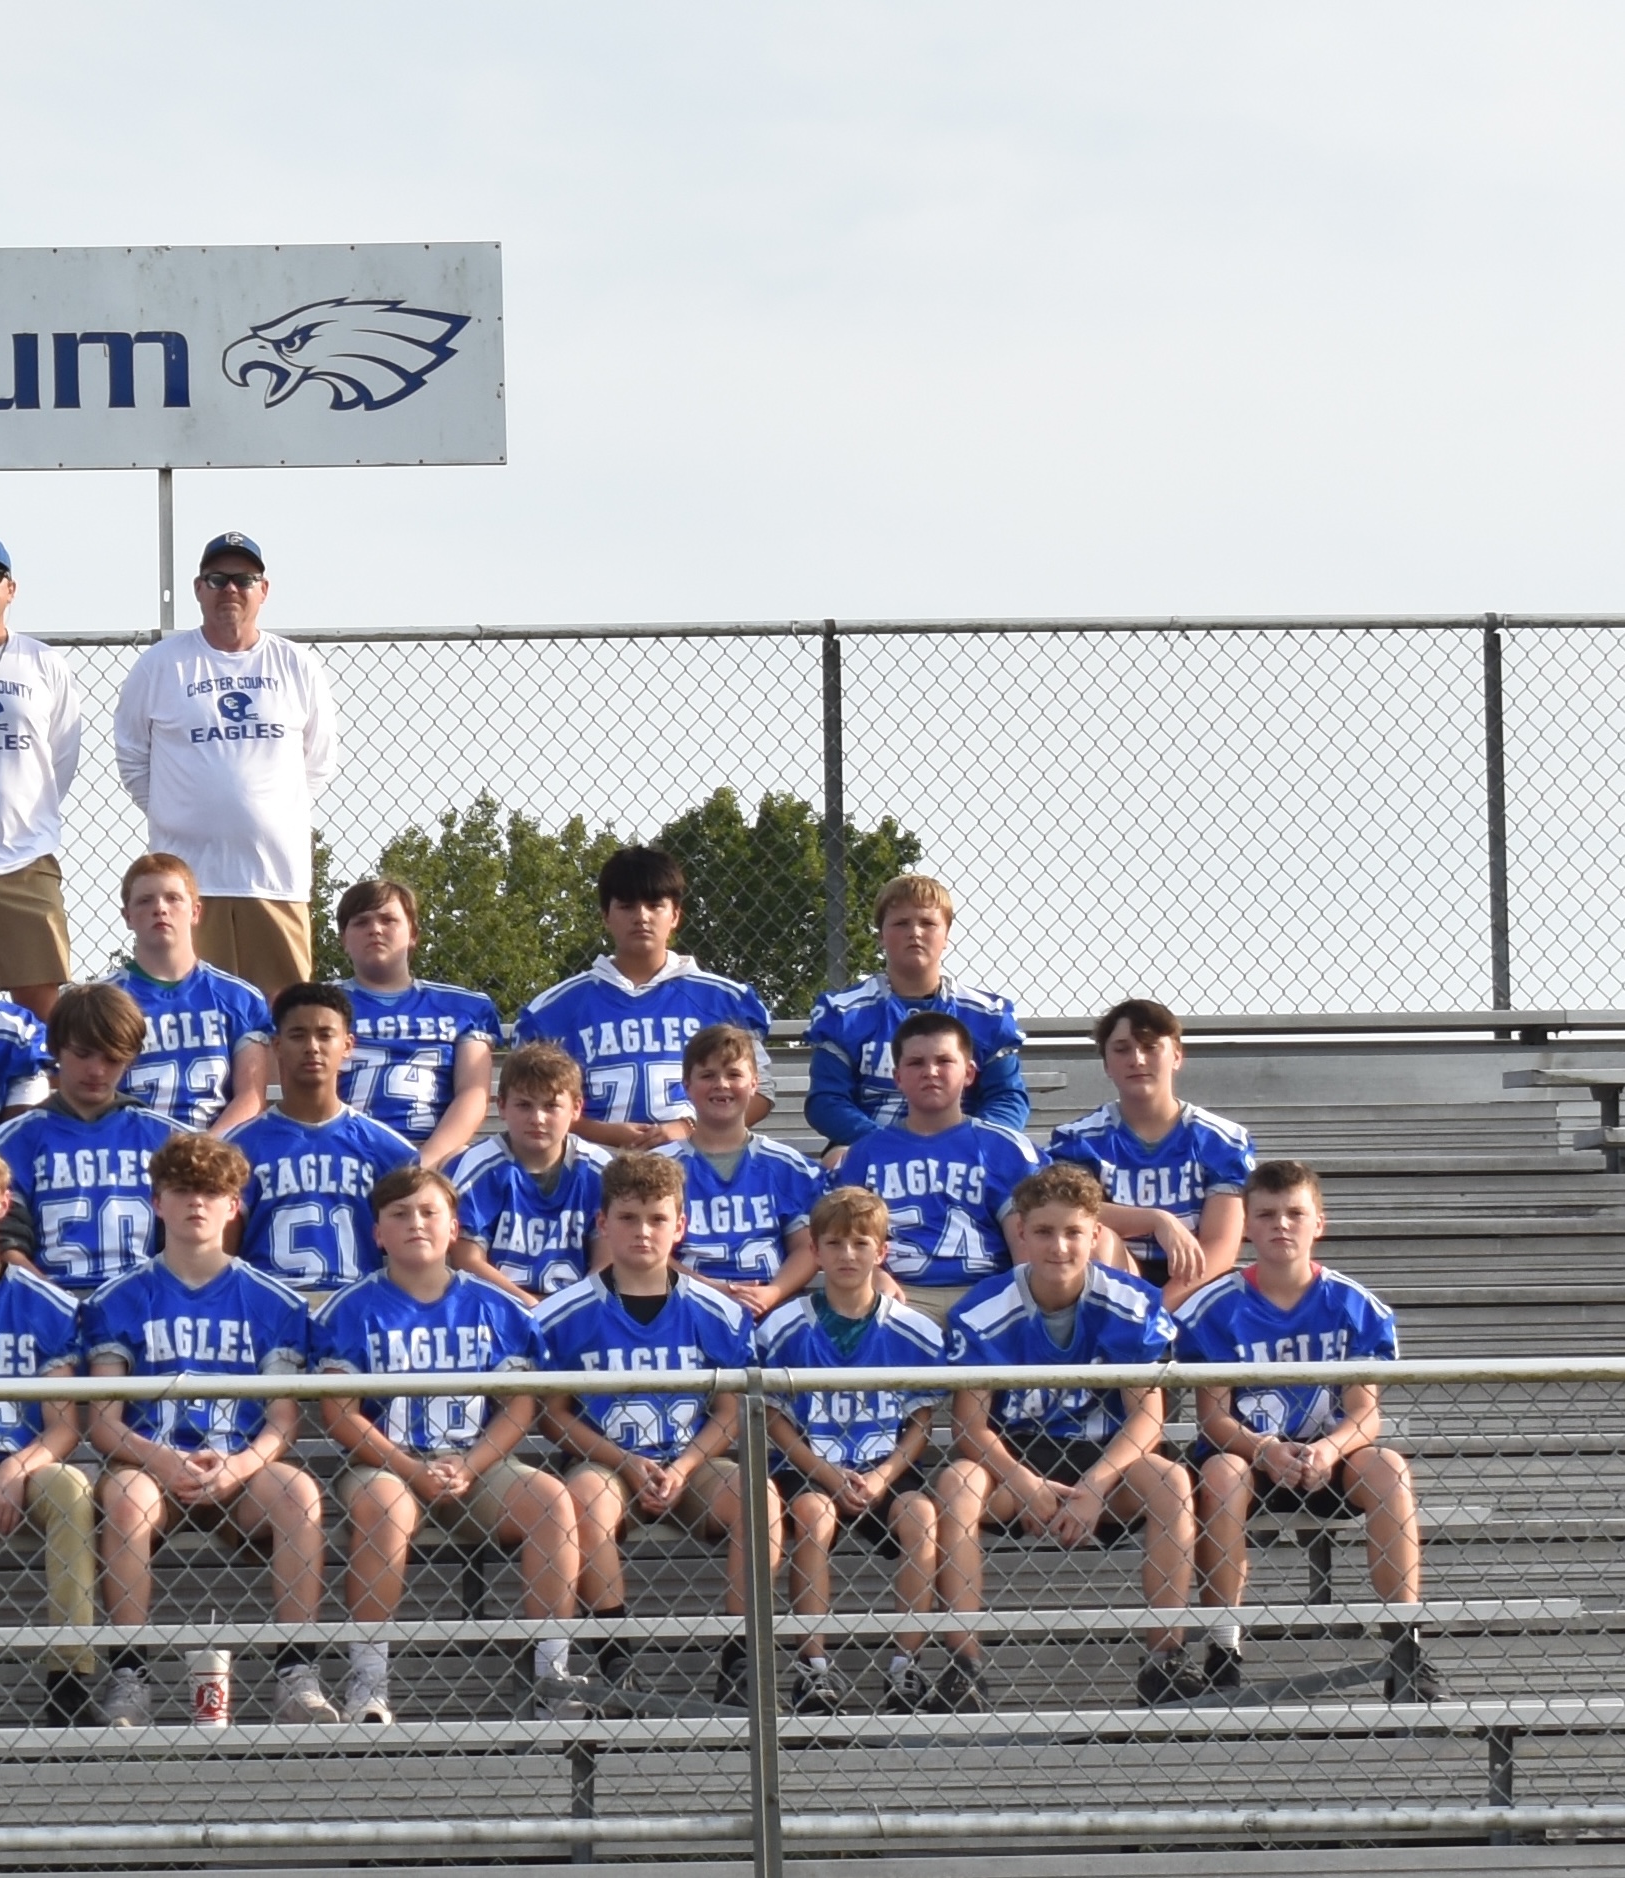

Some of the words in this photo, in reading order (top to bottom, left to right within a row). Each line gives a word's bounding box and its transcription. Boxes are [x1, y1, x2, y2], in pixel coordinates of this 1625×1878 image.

[186, 676, 234, 698] CHESTER
[236, 676, 280, 693] COUNTY
[189, 723, 285, 744] EAGLES
[34, 1148, 153, 1192] EAGLES
[254, 1153, 375, 1200] EAGLES
[39, 1196, 155, 1278] 50
[268, 1200, 363, 1288] 51
[368, 1323, 493, 1374] EAGLES
